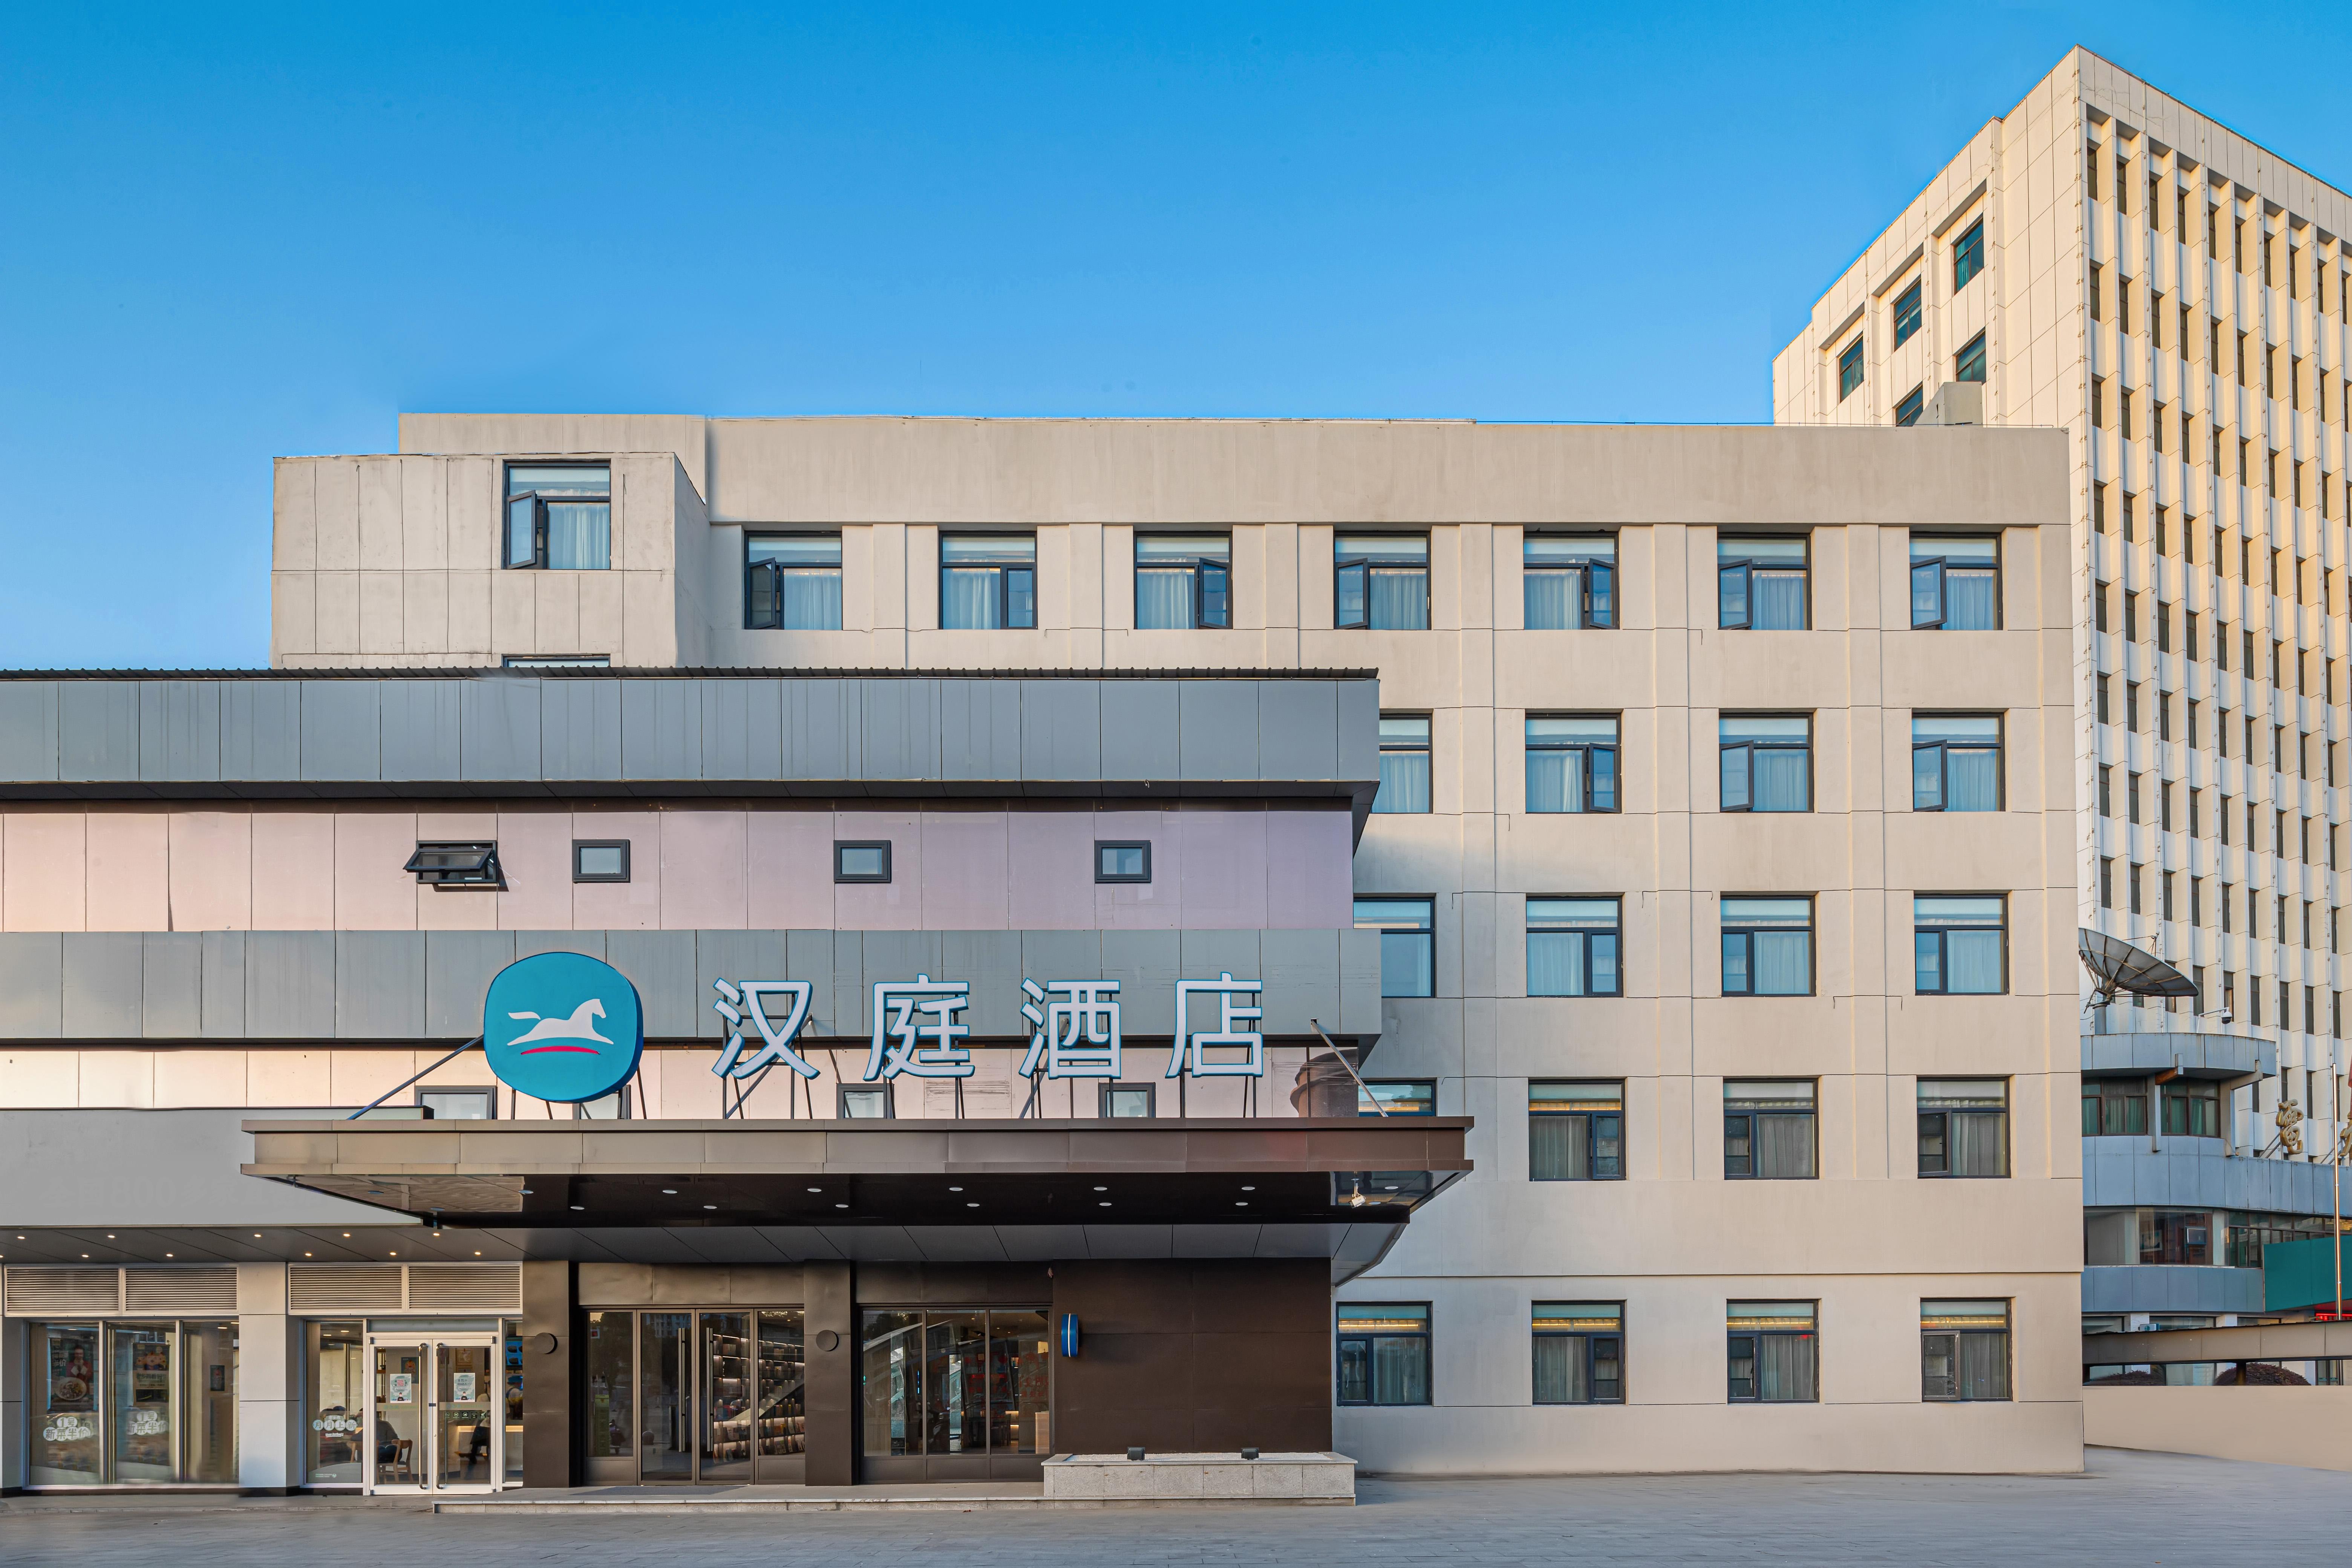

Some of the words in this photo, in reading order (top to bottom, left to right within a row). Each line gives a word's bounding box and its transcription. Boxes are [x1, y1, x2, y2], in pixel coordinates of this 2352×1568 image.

[711, 972, 1263, 1080] 汉庭酒店
[59, 1417, 75, 1428] 1号
[314, 1421, 357, 1429] 月月上新
[44, 1427, 90, 1441] 新菜半价
